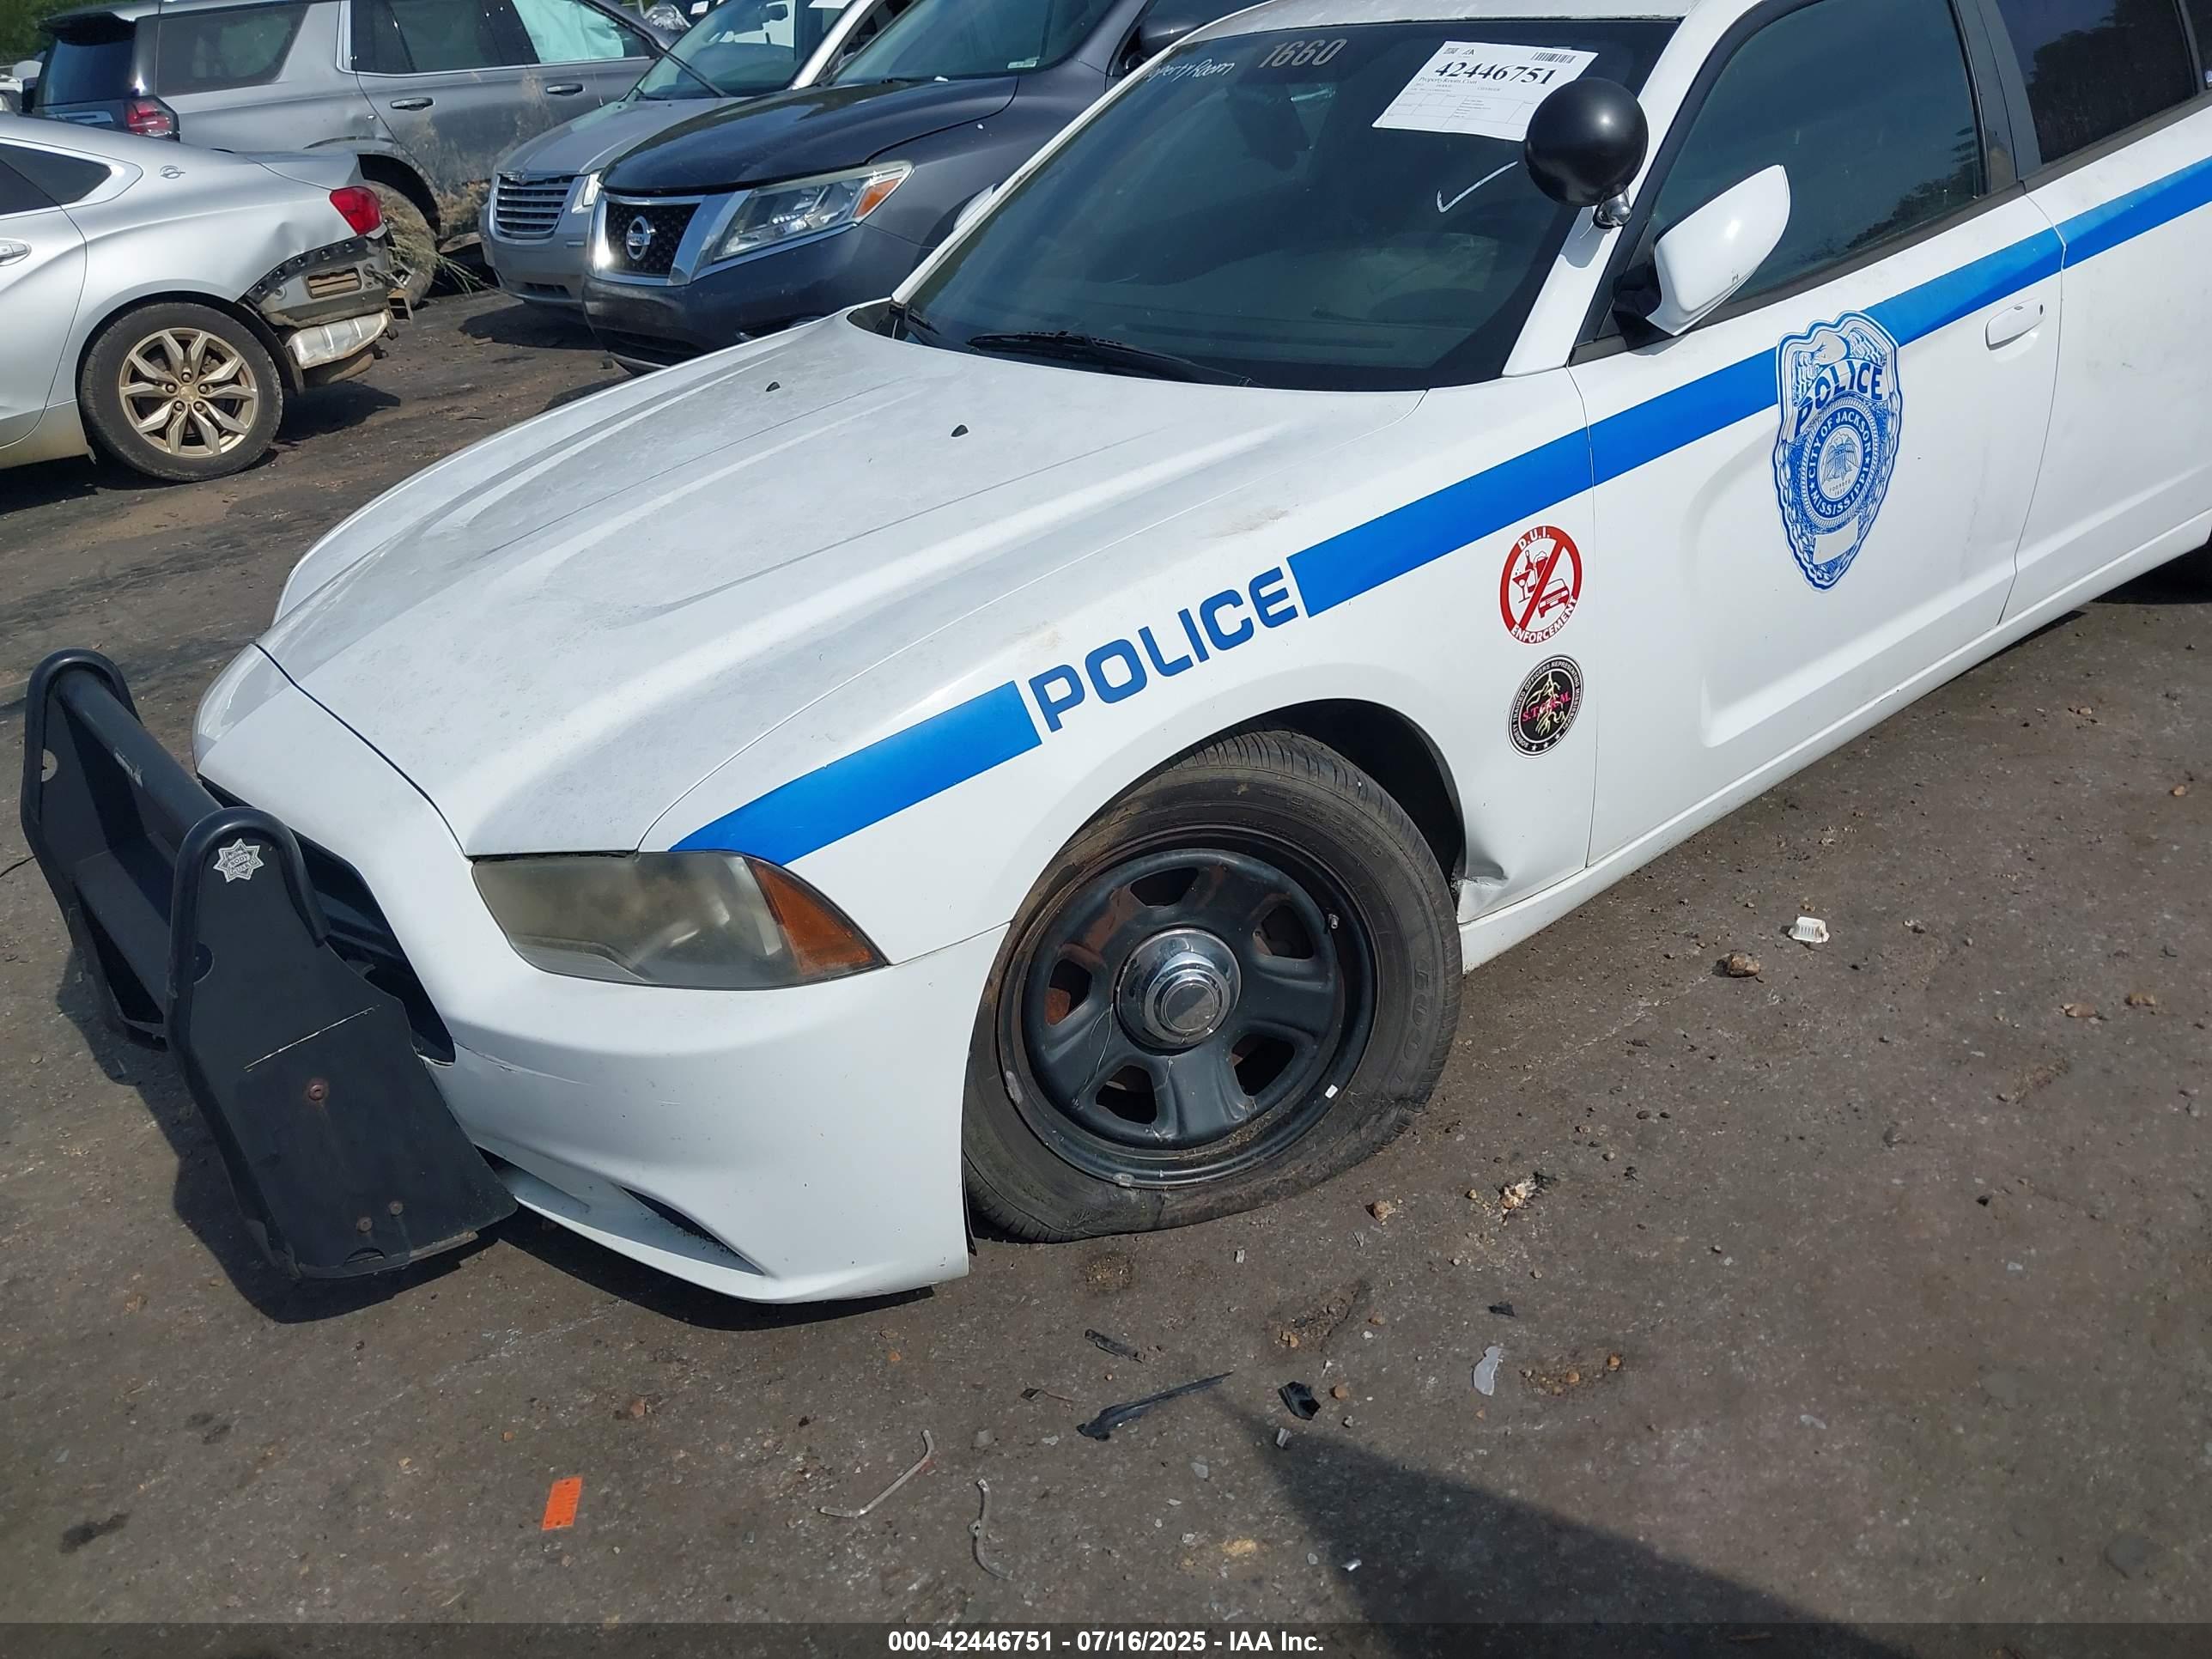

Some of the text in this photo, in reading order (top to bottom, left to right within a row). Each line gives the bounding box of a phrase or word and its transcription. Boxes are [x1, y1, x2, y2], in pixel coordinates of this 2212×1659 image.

[1258, 39, 1347, 68] 1660
[1435, 61, 1557, 84] 42446751
[1795, 361, 1883, 438] POLICE
[1808, 411, 1871, 478] CITY OF JACKSON
[1811, 467, 1869, 515] MISSISSIPPI
[1518, 526, 1550, 550] D.U.I.
[1511, 596, 1577, 642] ENFORCEMENT
[1029, 566, 1298, 732] POLICE
[1524, 664, 1551, 690] OFFICERS
[1551, 660, 1580, 687] REPRESENTING
[1512, 691, 1526, 723] TRAINED
[1513, 724, 1528, 748] SOBRIETY
